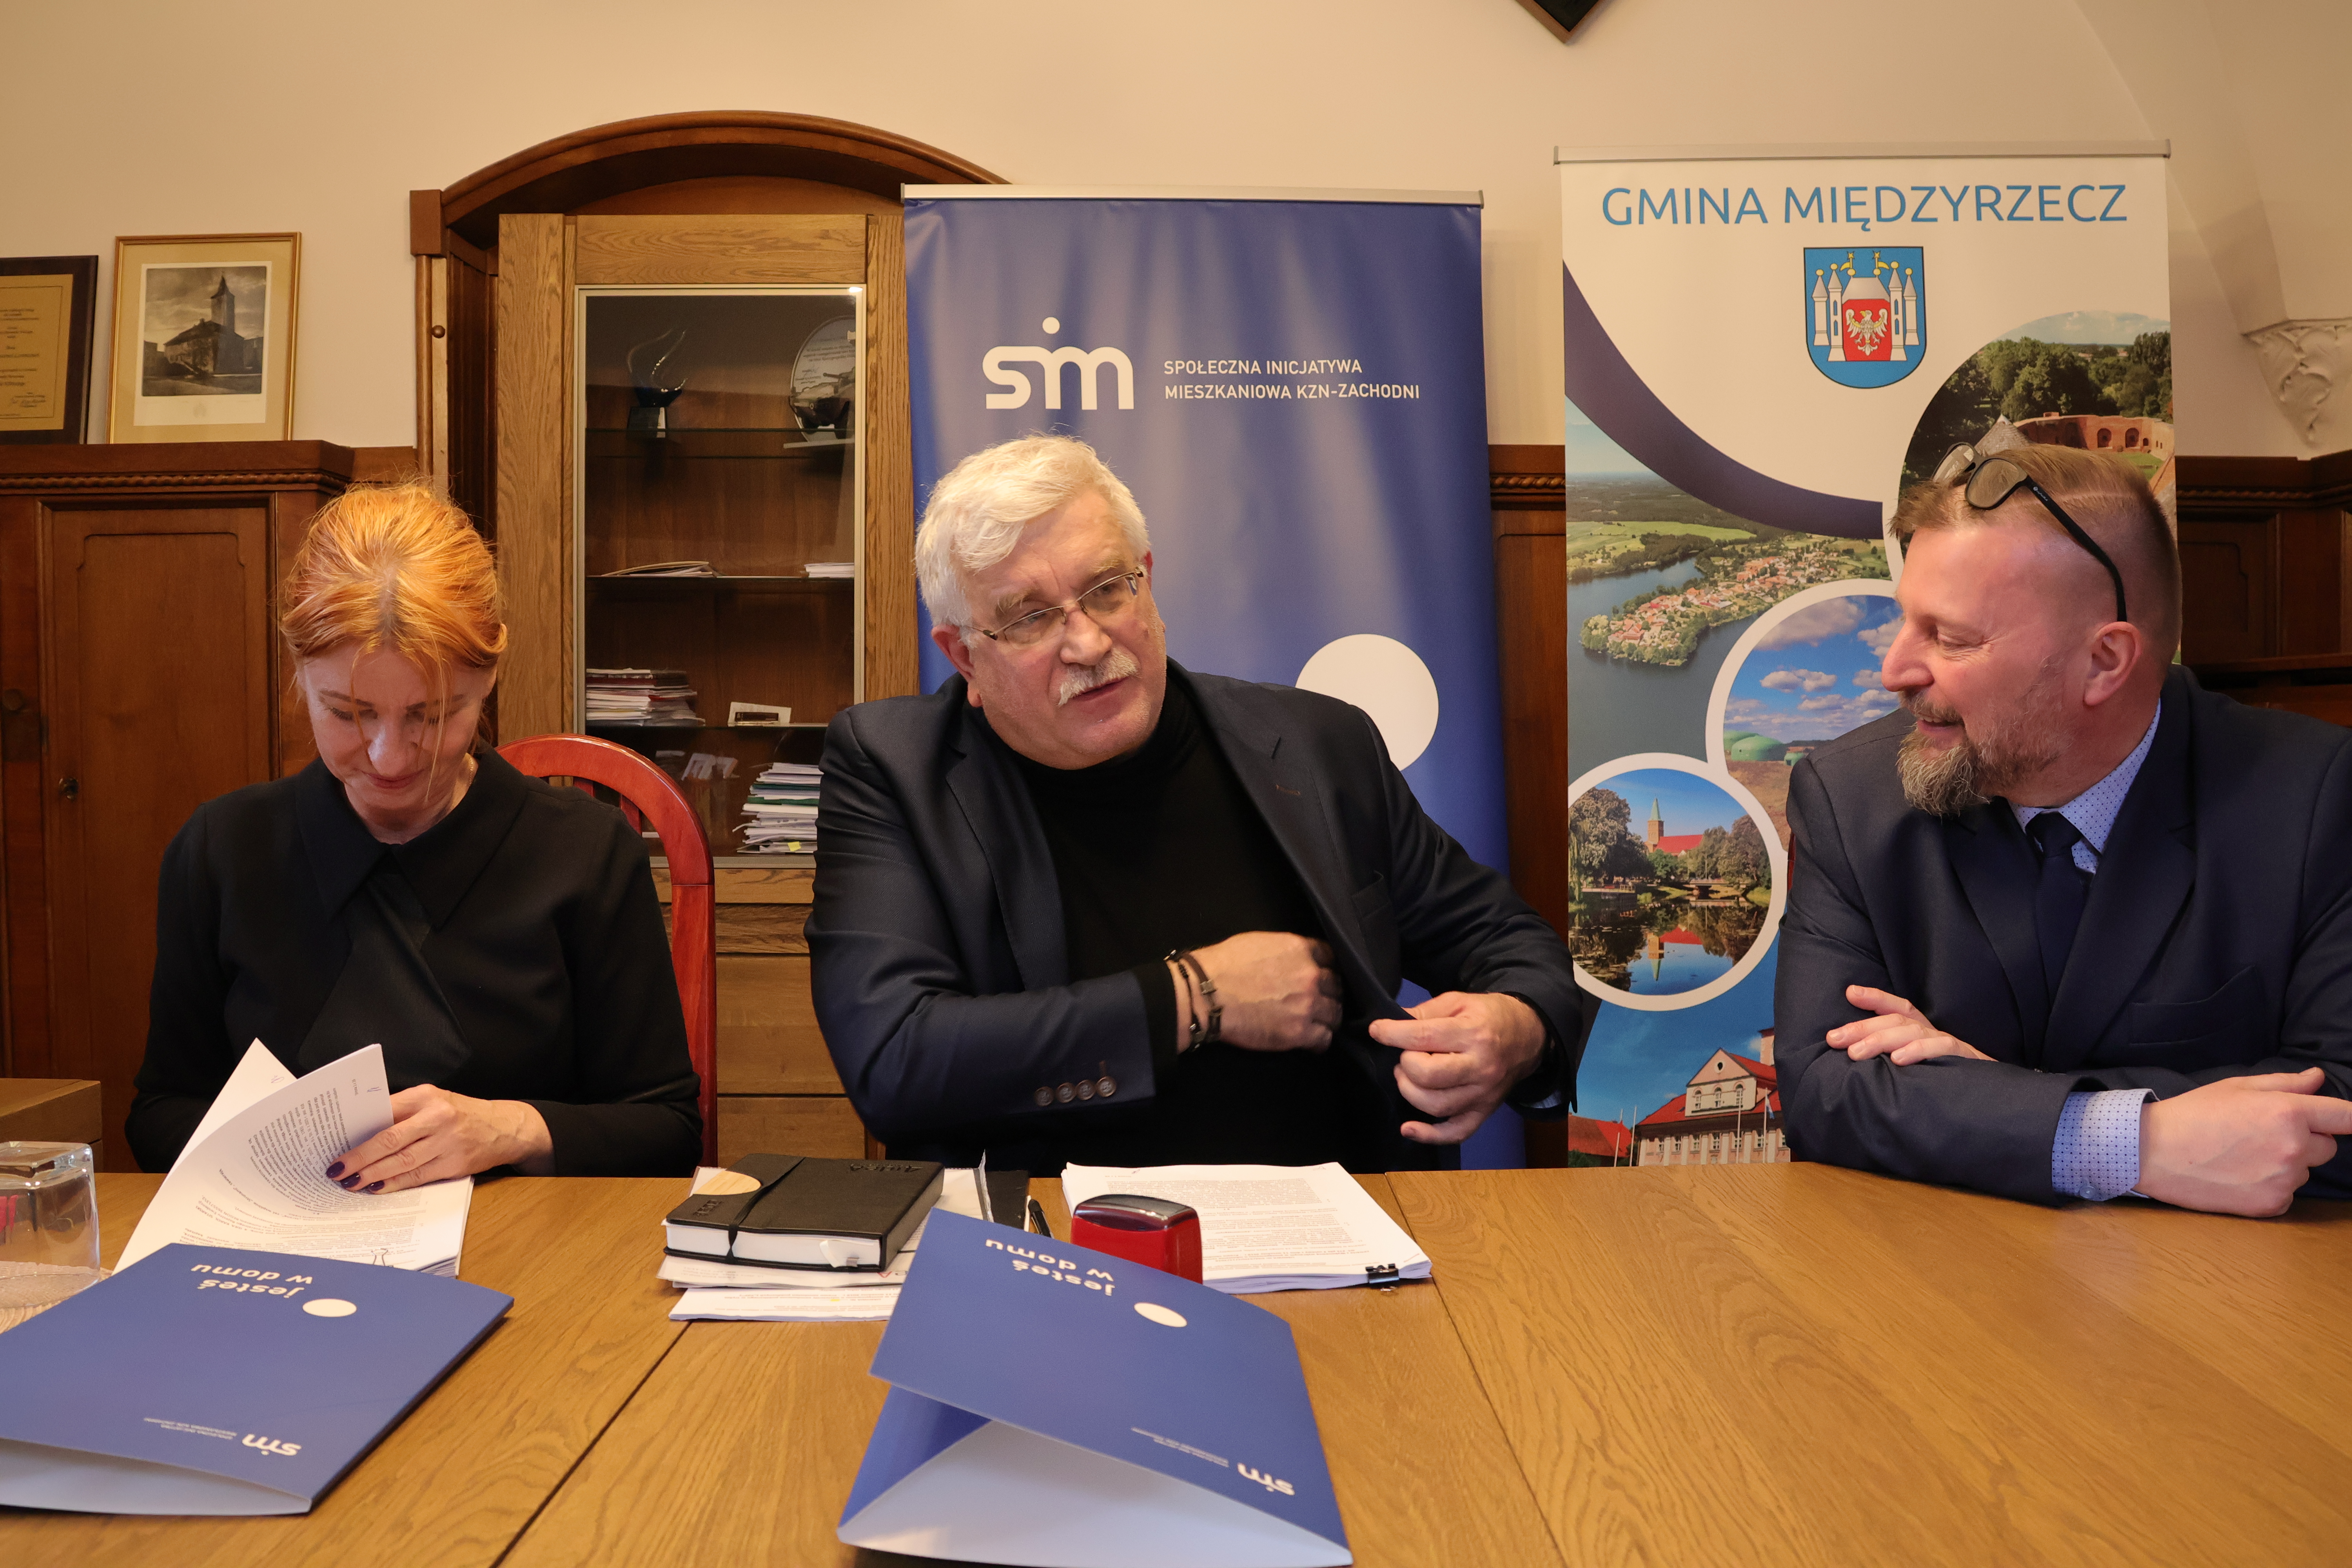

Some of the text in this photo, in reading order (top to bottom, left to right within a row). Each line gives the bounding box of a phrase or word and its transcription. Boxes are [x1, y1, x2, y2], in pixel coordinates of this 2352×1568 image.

[1602, 184, 2127, 232] GMINA MIĘDZYRZECZ
[982, 316, 1134, 410] sim
[1163, 359, 1363, 375] SPOŁECZNA INICJATYWA
[1165, 383, 1420, 399] MIESZKANIOWA KZN-ZACHODNI
[263, 1156, 278, 1175] niezbędnej
[257, 1169, 271, 1184] zawarcia
[285, 1167, 298, 1181] prawem
[275, 1187, 290, 1198] prawne
[195, 1205, 213, 1218] SITARSKI
[197, 1200, 216, 1215] Ewidencji
[214, 1217, 230, 1226] KAROL
[217, 1213, 235, 1223] Rejestru
[223, 1211, 239, 1221] REGON
[985, 1239, 1114, 1281] w domu
[191, 1264, 313, 1284] w domu
[1012, 1259, 1115, 1296] jesteś
[197, 1279, 305, 1298] jesteś
[242, 1433, 302, 1456] sim
[1237, 1463, 1295, 1495] sim
